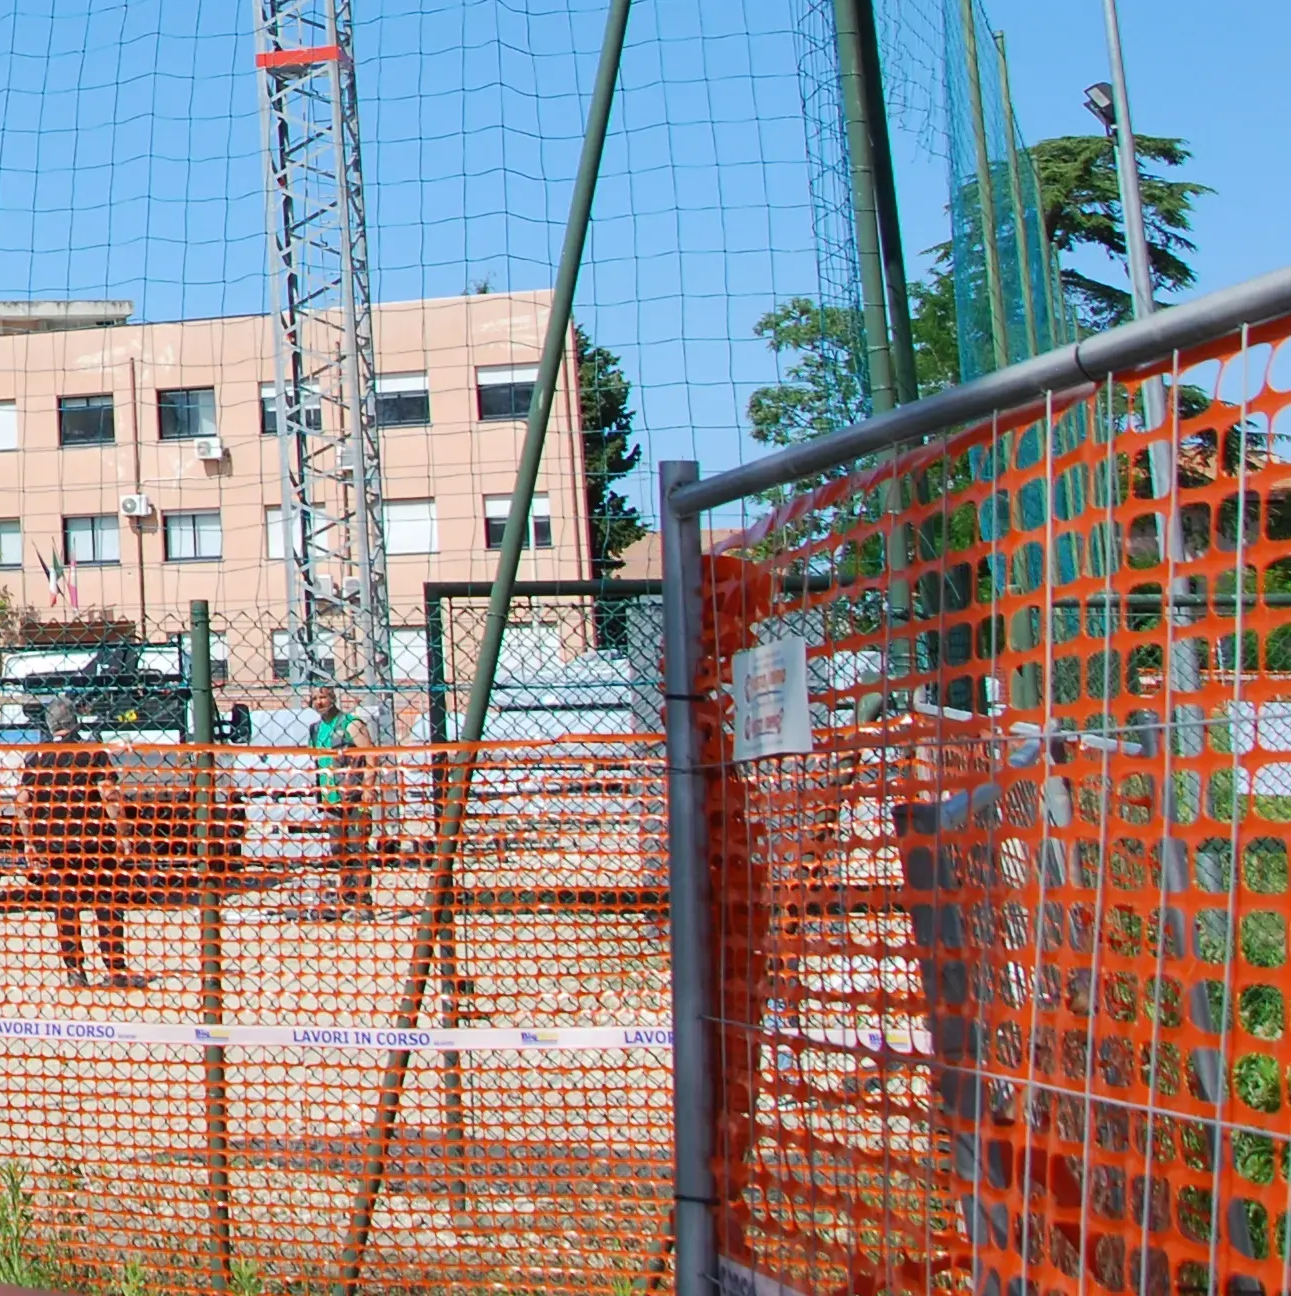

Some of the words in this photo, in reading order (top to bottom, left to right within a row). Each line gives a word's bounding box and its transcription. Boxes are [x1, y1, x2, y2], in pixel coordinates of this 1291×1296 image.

[45, 1022, 61, 1036] IN
[66, 1024, 115, 1038] CORSO
[293, 1029, 349, 1044] LAVORI
[355, 1030, 371, 1045] IN
[376, 1032, 430, 1046] CORSO
